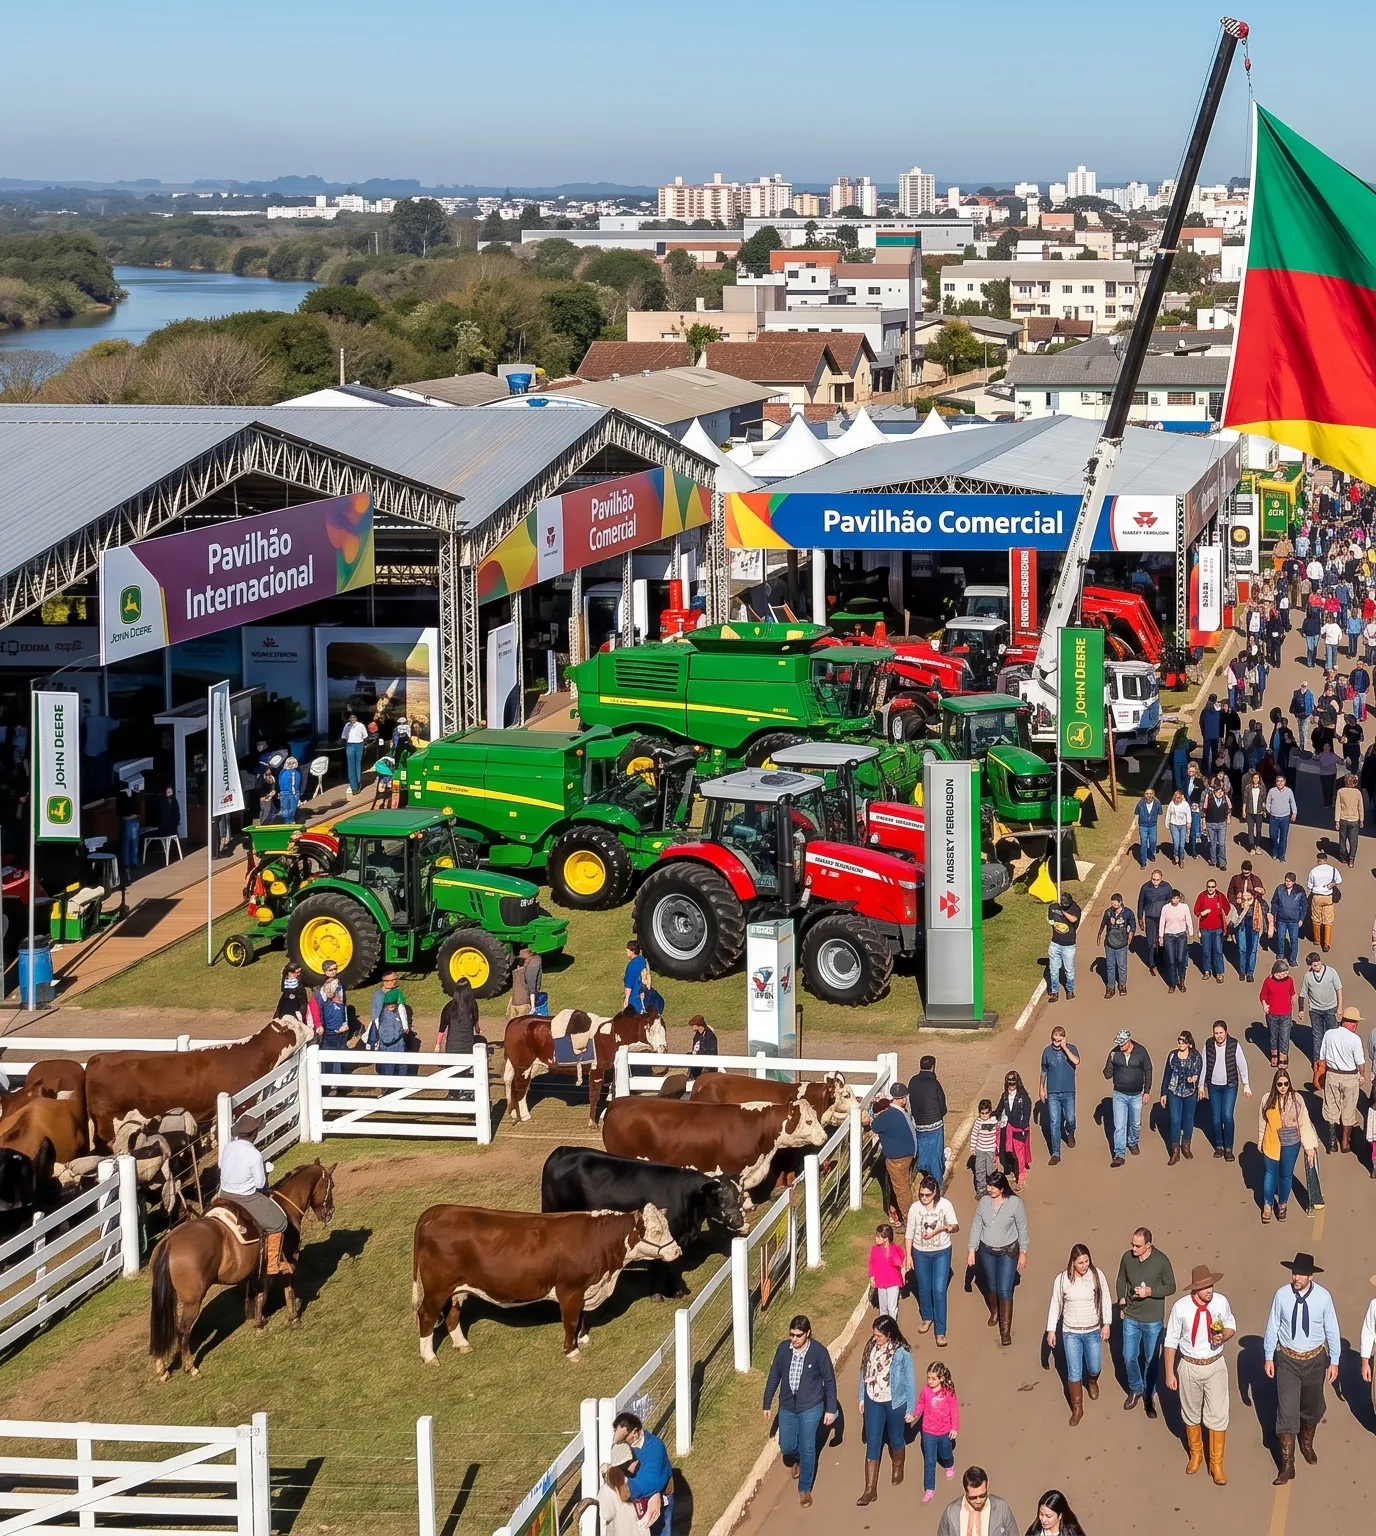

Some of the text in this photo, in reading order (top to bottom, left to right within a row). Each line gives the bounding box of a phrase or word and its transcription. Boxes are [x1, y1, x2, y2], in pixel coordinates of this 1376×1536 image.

[591, 488, 634, 522] Pavilhão
[824, 509, 1062, 534] Pavilhão Comercial
[589, 513, 636, 550] Comercial
[208, 528, 292, 574] Pavilhão
[186, 555, 314, 620] Internacional
[1075, 680, 1088, 718] JOHN
[54, 704, 66, 790] JOHN DEERE
